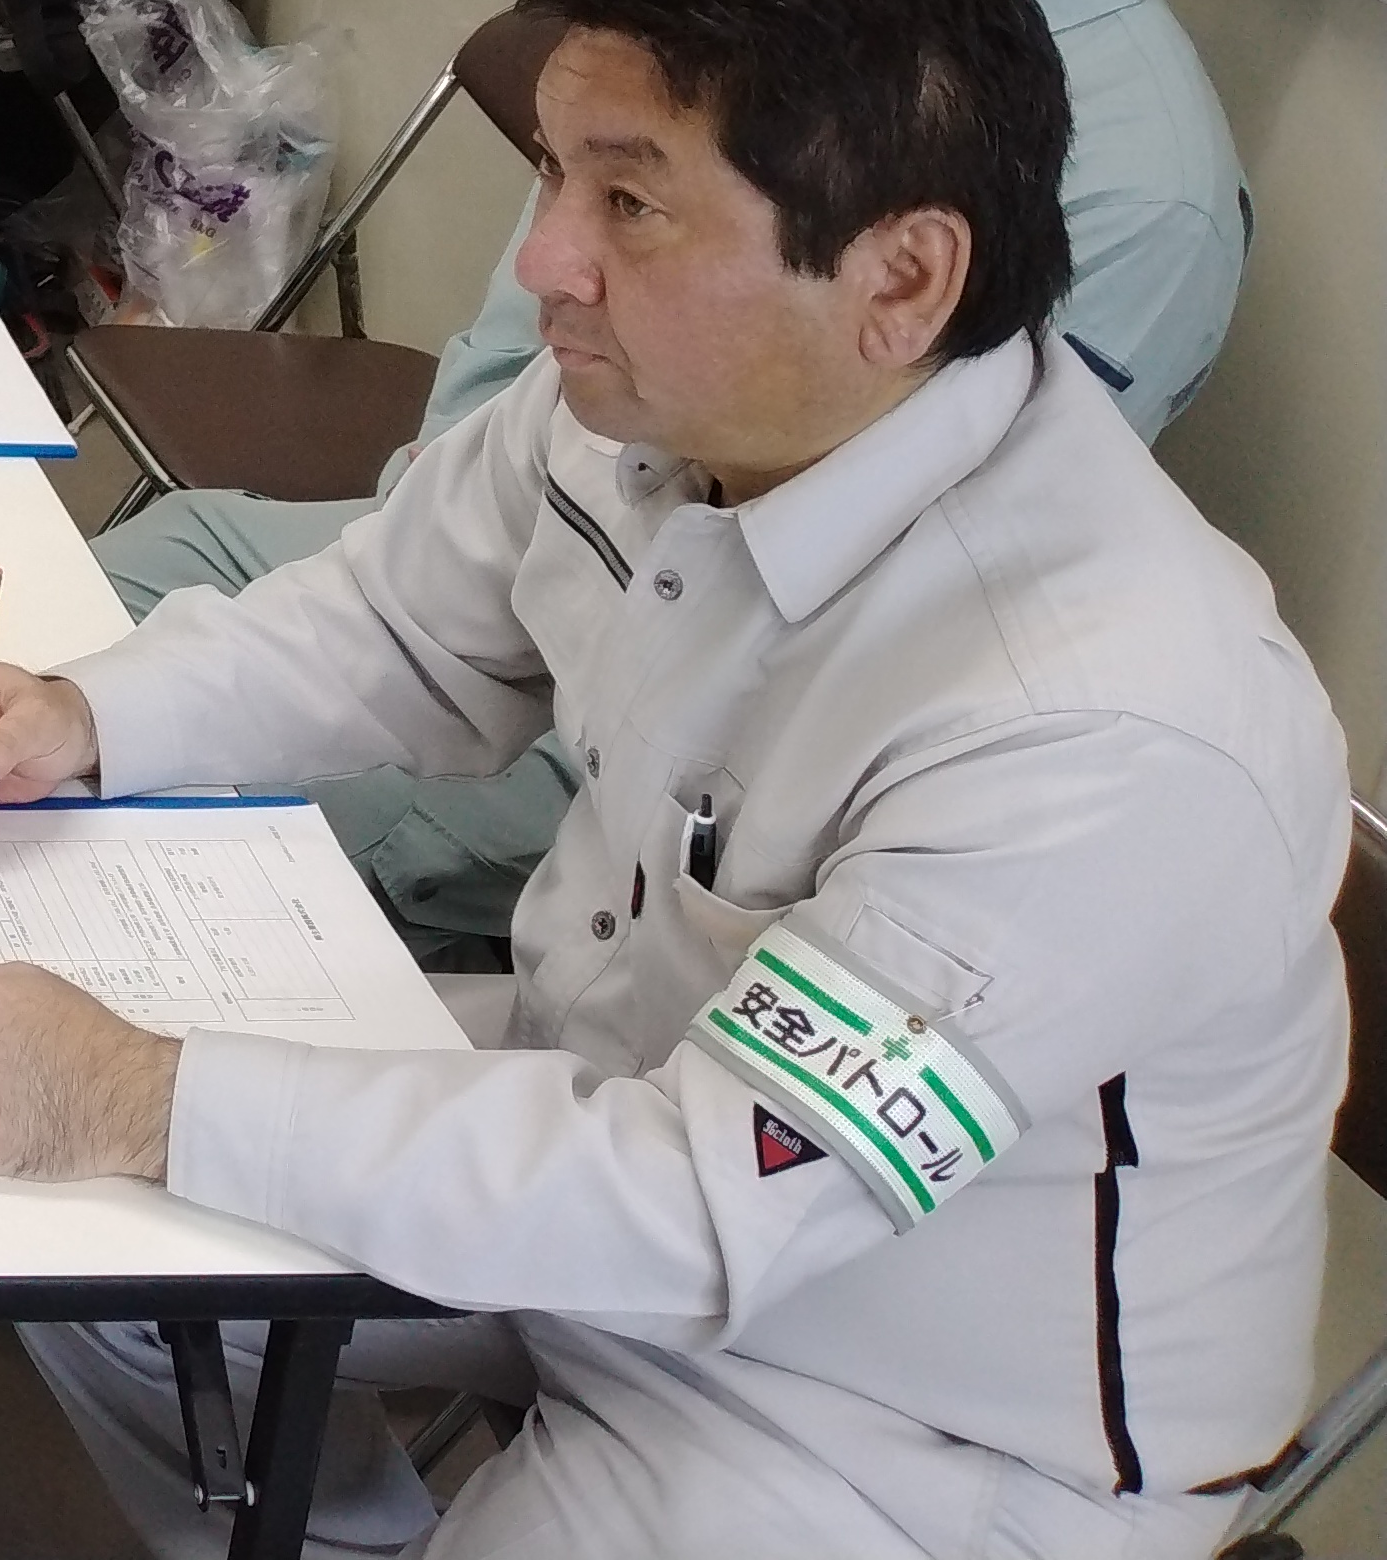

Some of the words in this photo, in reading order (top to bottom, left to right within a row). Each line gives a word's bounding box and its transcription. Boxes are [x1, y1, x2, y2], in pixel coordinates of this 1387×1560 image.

[731, 981, 965, 1183] 安全パトロール
